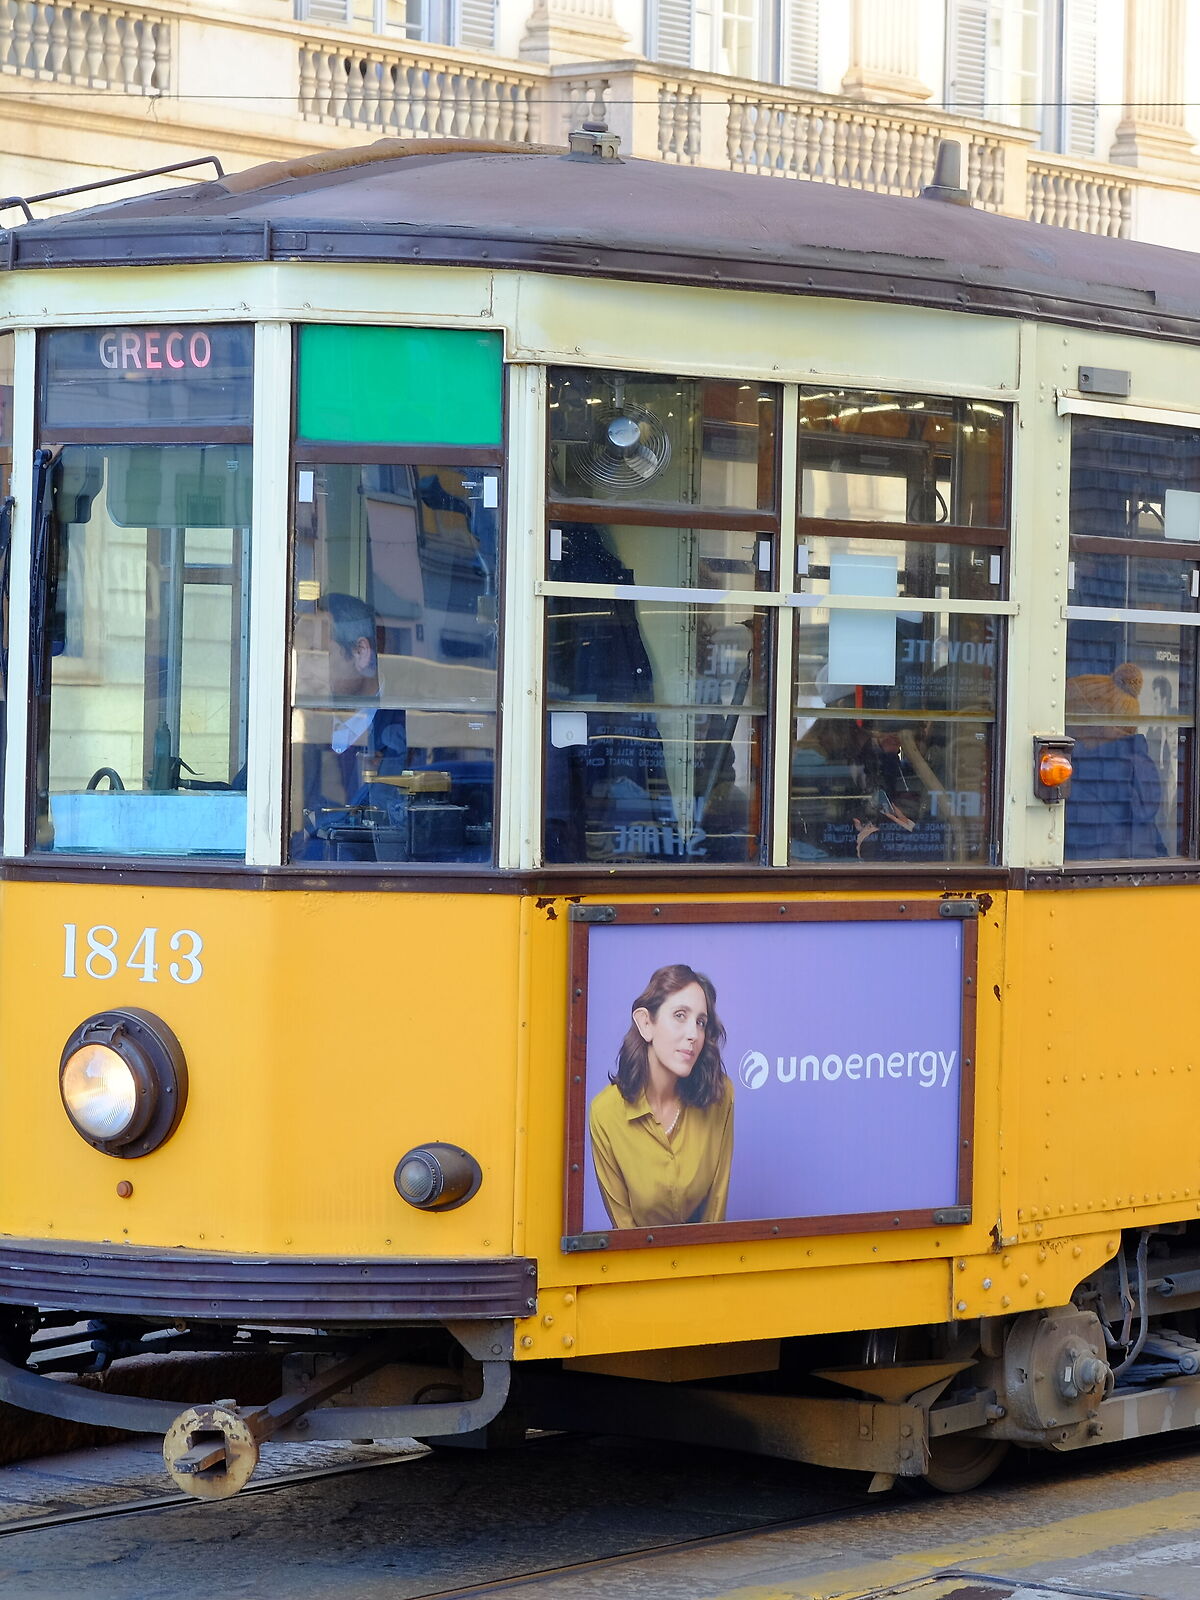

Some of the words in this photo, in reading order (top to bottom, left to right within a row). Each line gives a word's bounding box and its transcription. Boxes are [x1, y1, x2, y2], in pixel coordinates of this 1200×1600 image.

[99, 330, 213, 369] GRECO
[62, 923, 205, 985] 1843
[777, 1049, 957, 1089] unoenergy
